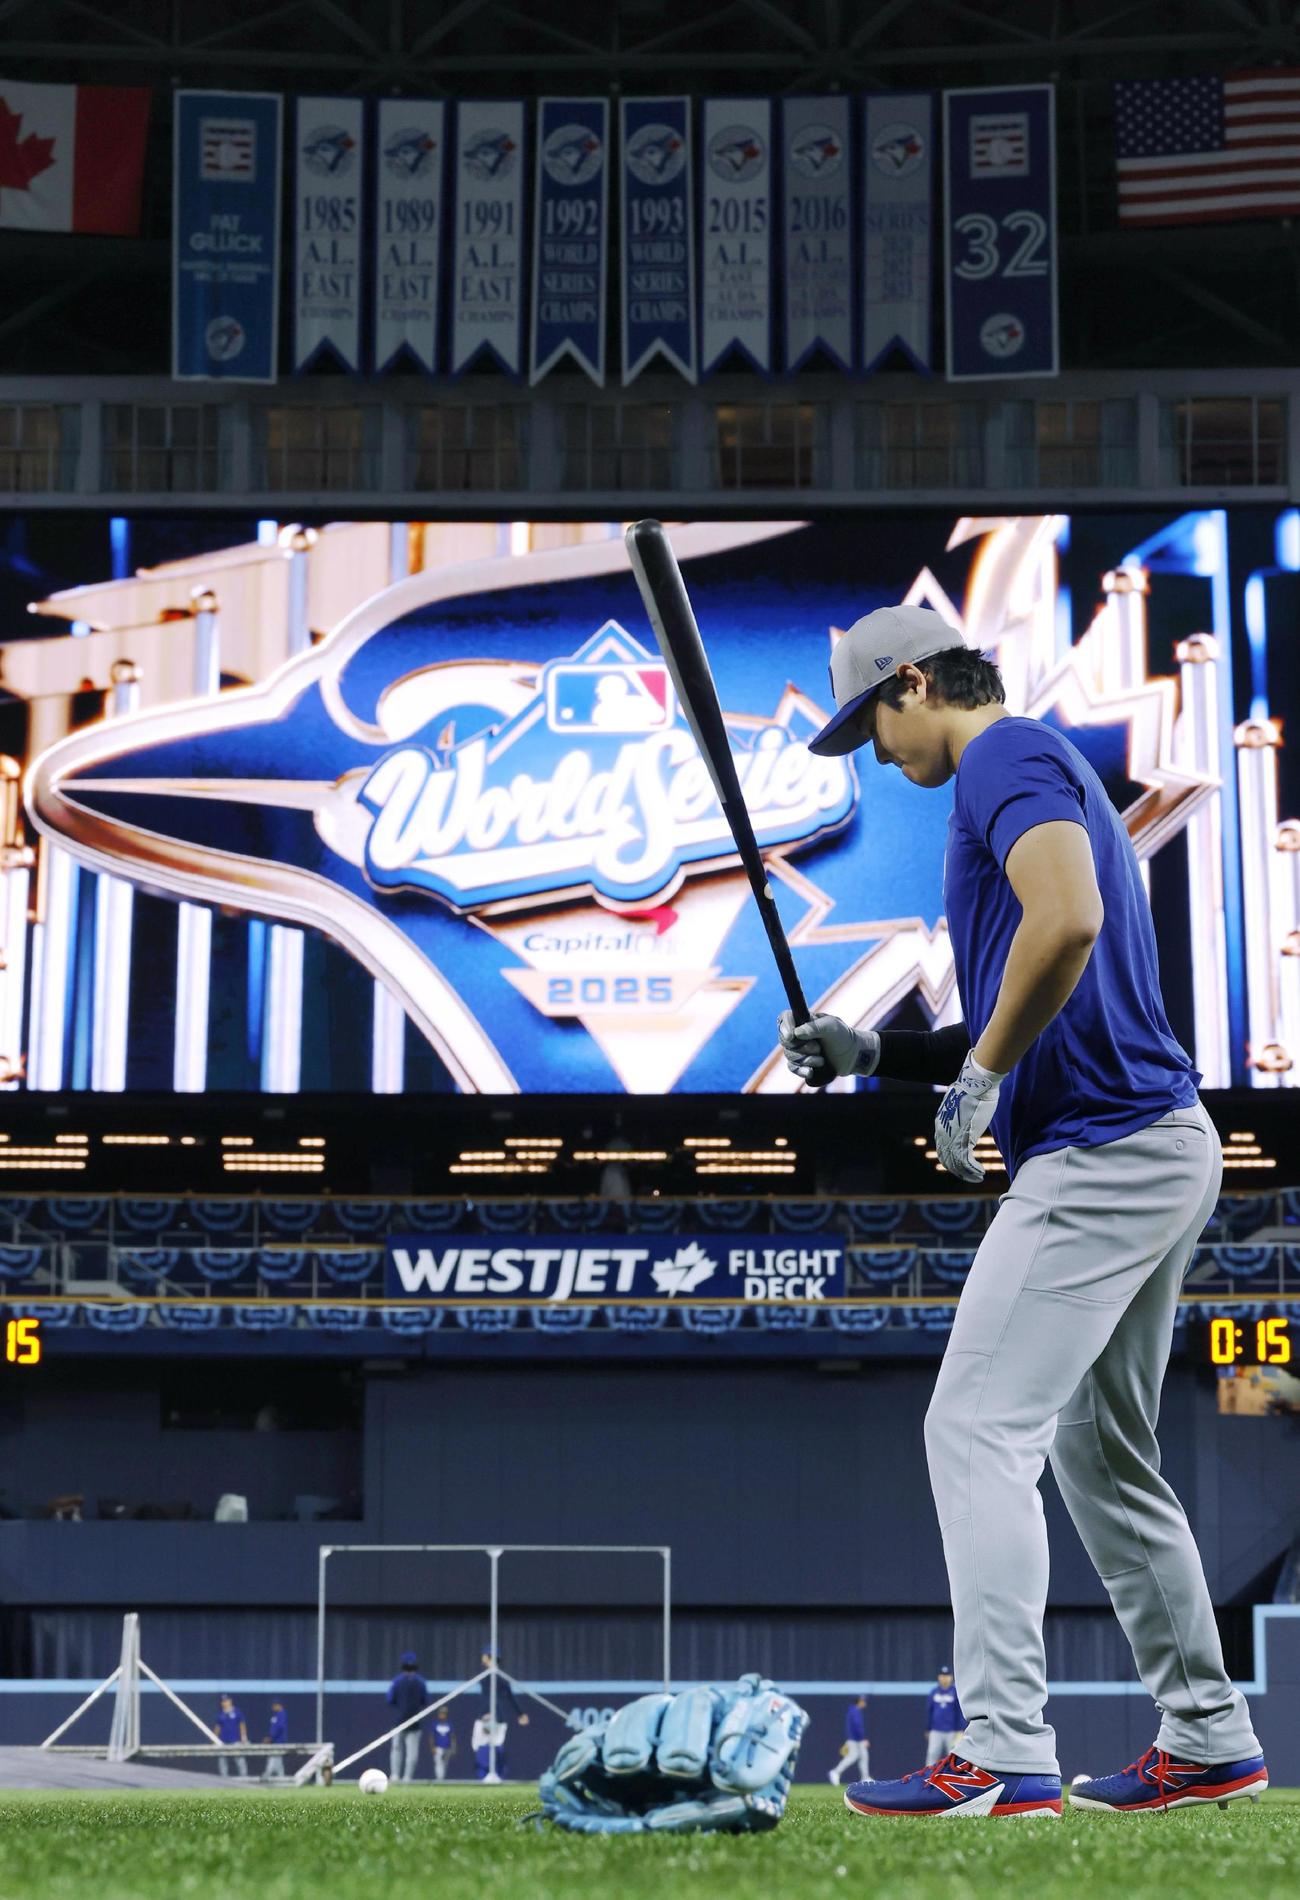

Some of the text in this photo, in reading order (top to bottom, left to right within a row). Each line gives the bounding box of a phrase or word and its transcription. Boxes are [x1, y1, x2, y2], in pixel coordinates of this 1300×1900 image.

[303, 196, 356, 233] 1985
[384, 198, 435, 234] 1989
[463, 200, 513, 236] 1991
[545, 198, 598, 236] 1992
[631, 196, 685, 235] 1993
[709, 196, 766, 233] 2015
[791, 195, 846, 233] 2016
[954, 210, 1048, 280] 32
[302, 272, 354, 299] EAST
[383, 274, 433, 301] EAST
[461, 275, 515, 302] EAST
[364, 738, 640, 869] World
[547, 976, 673, 1004] 2025
[391, 1248, 650, 1301] WESTJET
[728, 1249, 842, 1277] FLIGHT
[744, 1276, 827, 1301] DECK
[6, 1318, 41, 1364] 15
[1210, 1318, 1290, 1364] 0:15
